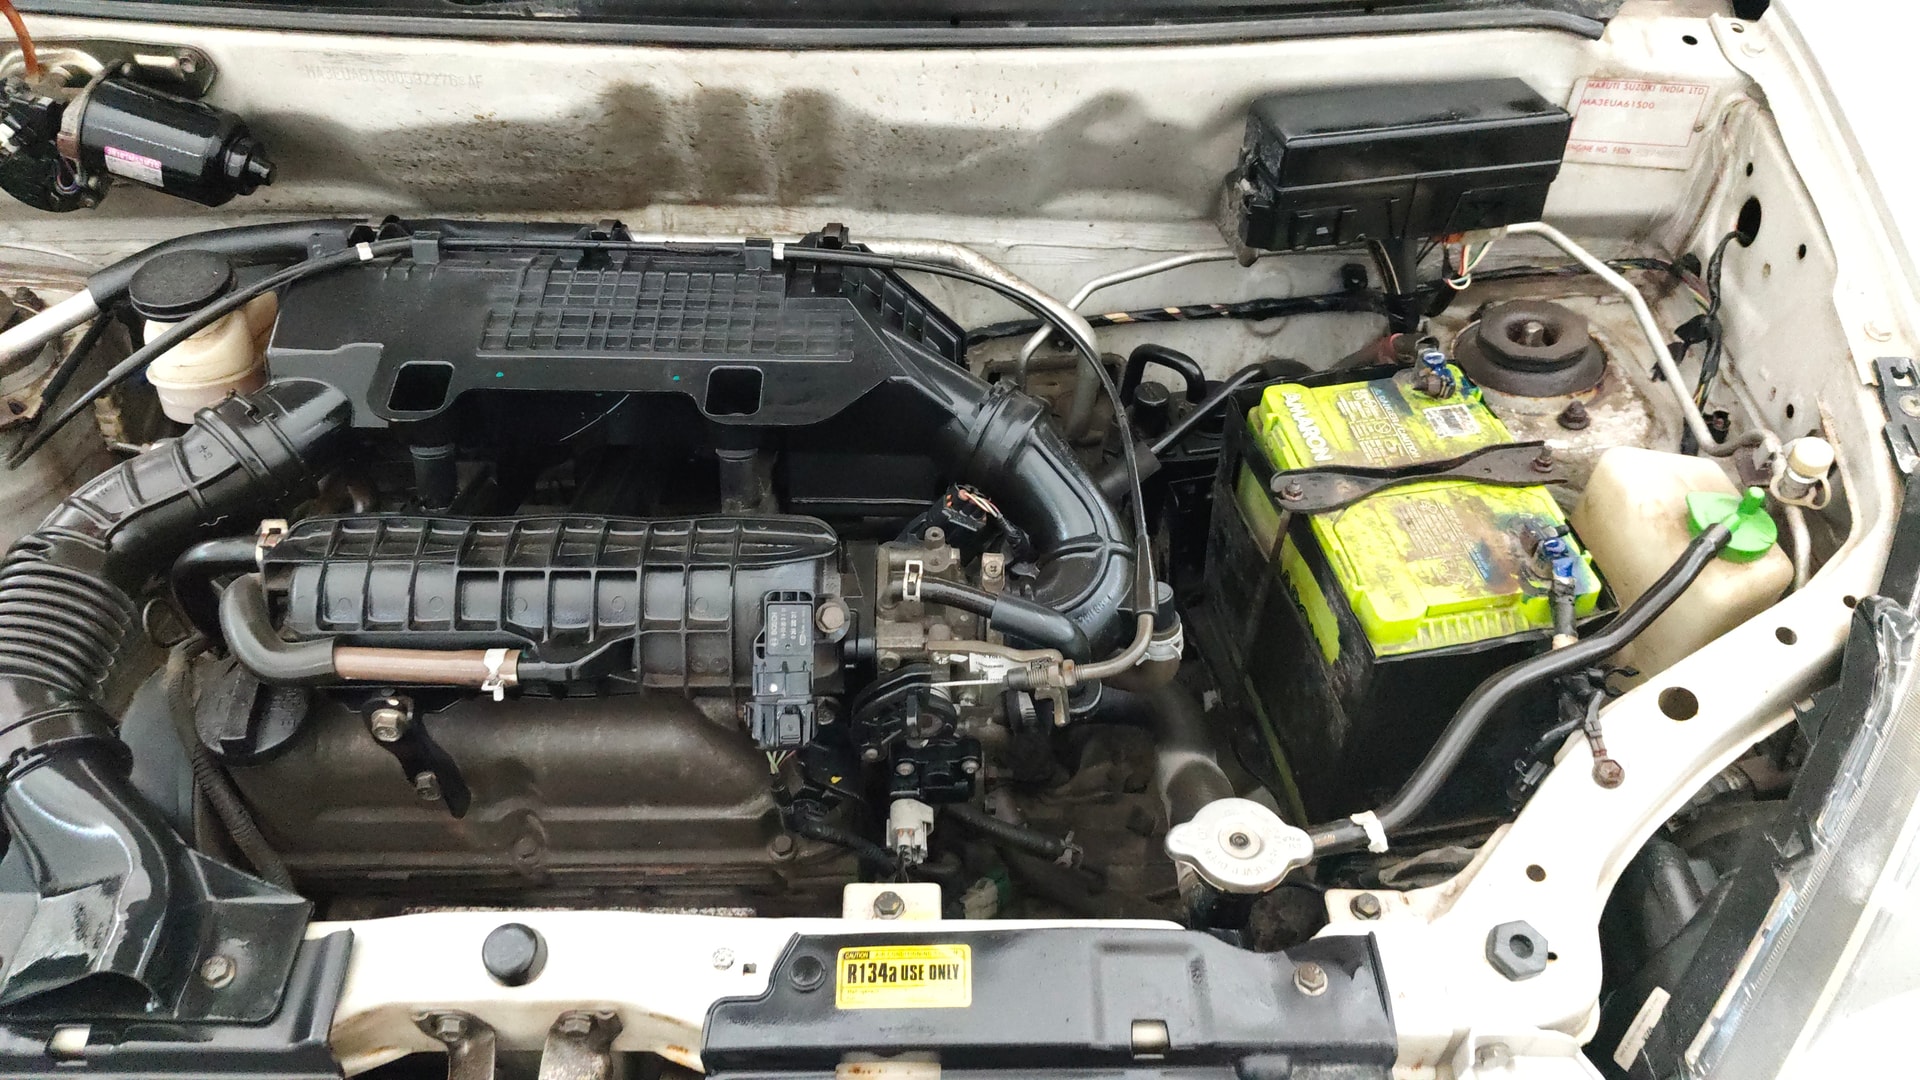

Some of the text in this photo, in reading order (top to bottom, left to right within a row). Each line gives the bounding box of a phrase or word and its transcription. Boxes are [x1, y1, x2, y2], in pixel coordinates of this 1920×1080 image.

[1587, 81, 1621, 90] MARUTI
[1623, 82, 1656, 92] SUZUKI
[1660, 85, 1685, 95] INDIA
[1282, 391, 1334, 462] AMARON
[1396, 427, 1422, 459] CAUTION
[844, 951, 869, 960] CAUTION
[847, 962, 960, 984] R134a USE ONLY
